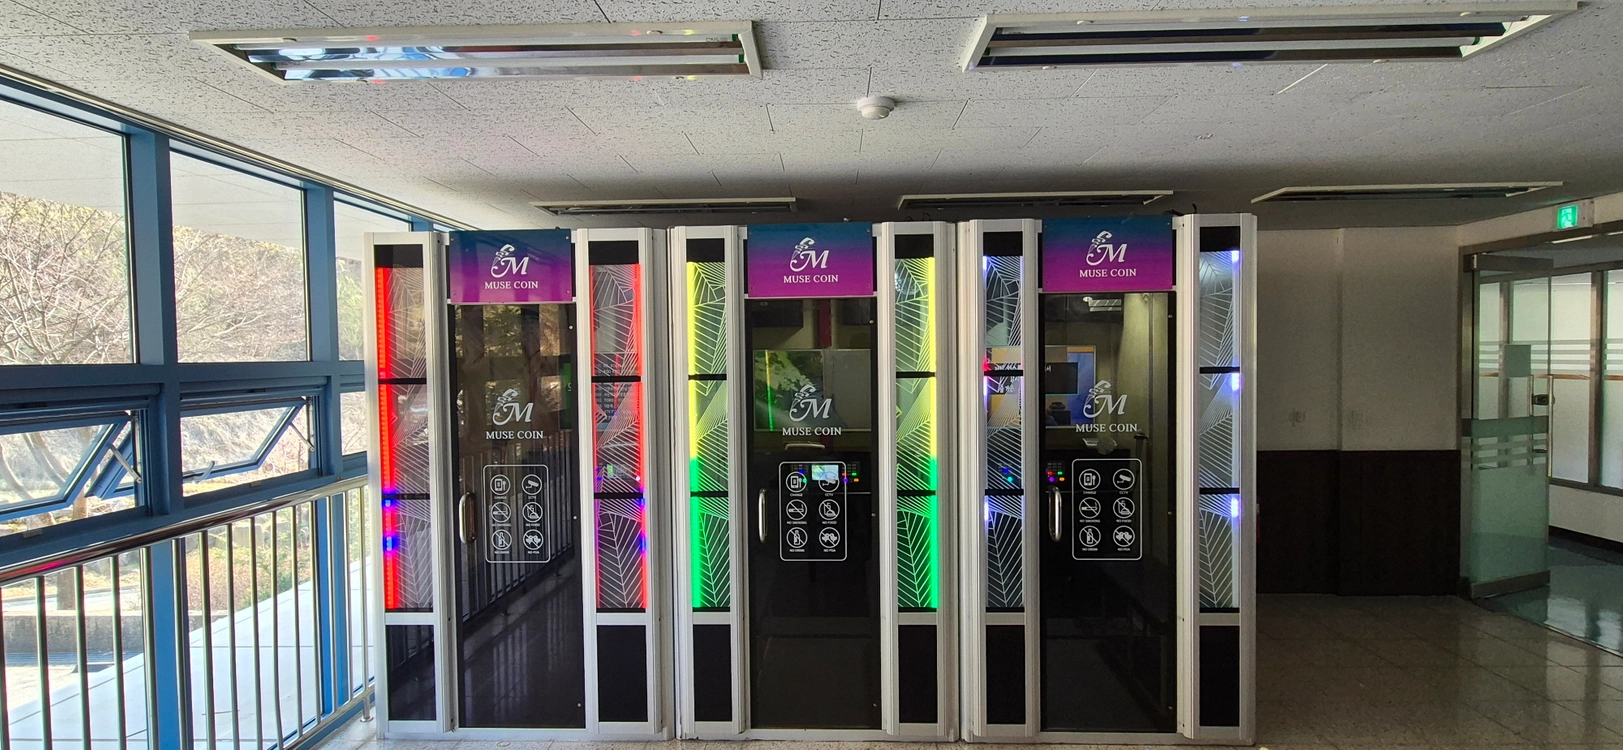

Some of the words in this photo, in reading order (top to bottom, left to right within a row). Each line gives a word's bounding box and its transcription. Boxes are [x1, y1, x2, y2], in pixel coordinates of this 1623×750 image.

[1079, 269, 1108, 278] MUSE
[1110, 268, 1137, 277] COIN
[783, 275, 810, 284] MUSE
[812, 274, 839, 283] COIN
[484, 281, 512, 289] MUSE
[514, 280, 538, 289] COIN
[782, 427, 812, 436] MUSE
[814, 426, 842, 436] COIN
[1075, 424, 1106, 433] MUSE
[1109, 424, 1138, 432] COIN
[486, 430, 514, 440] MUSE
[517, 430, 544, 439] COIN
